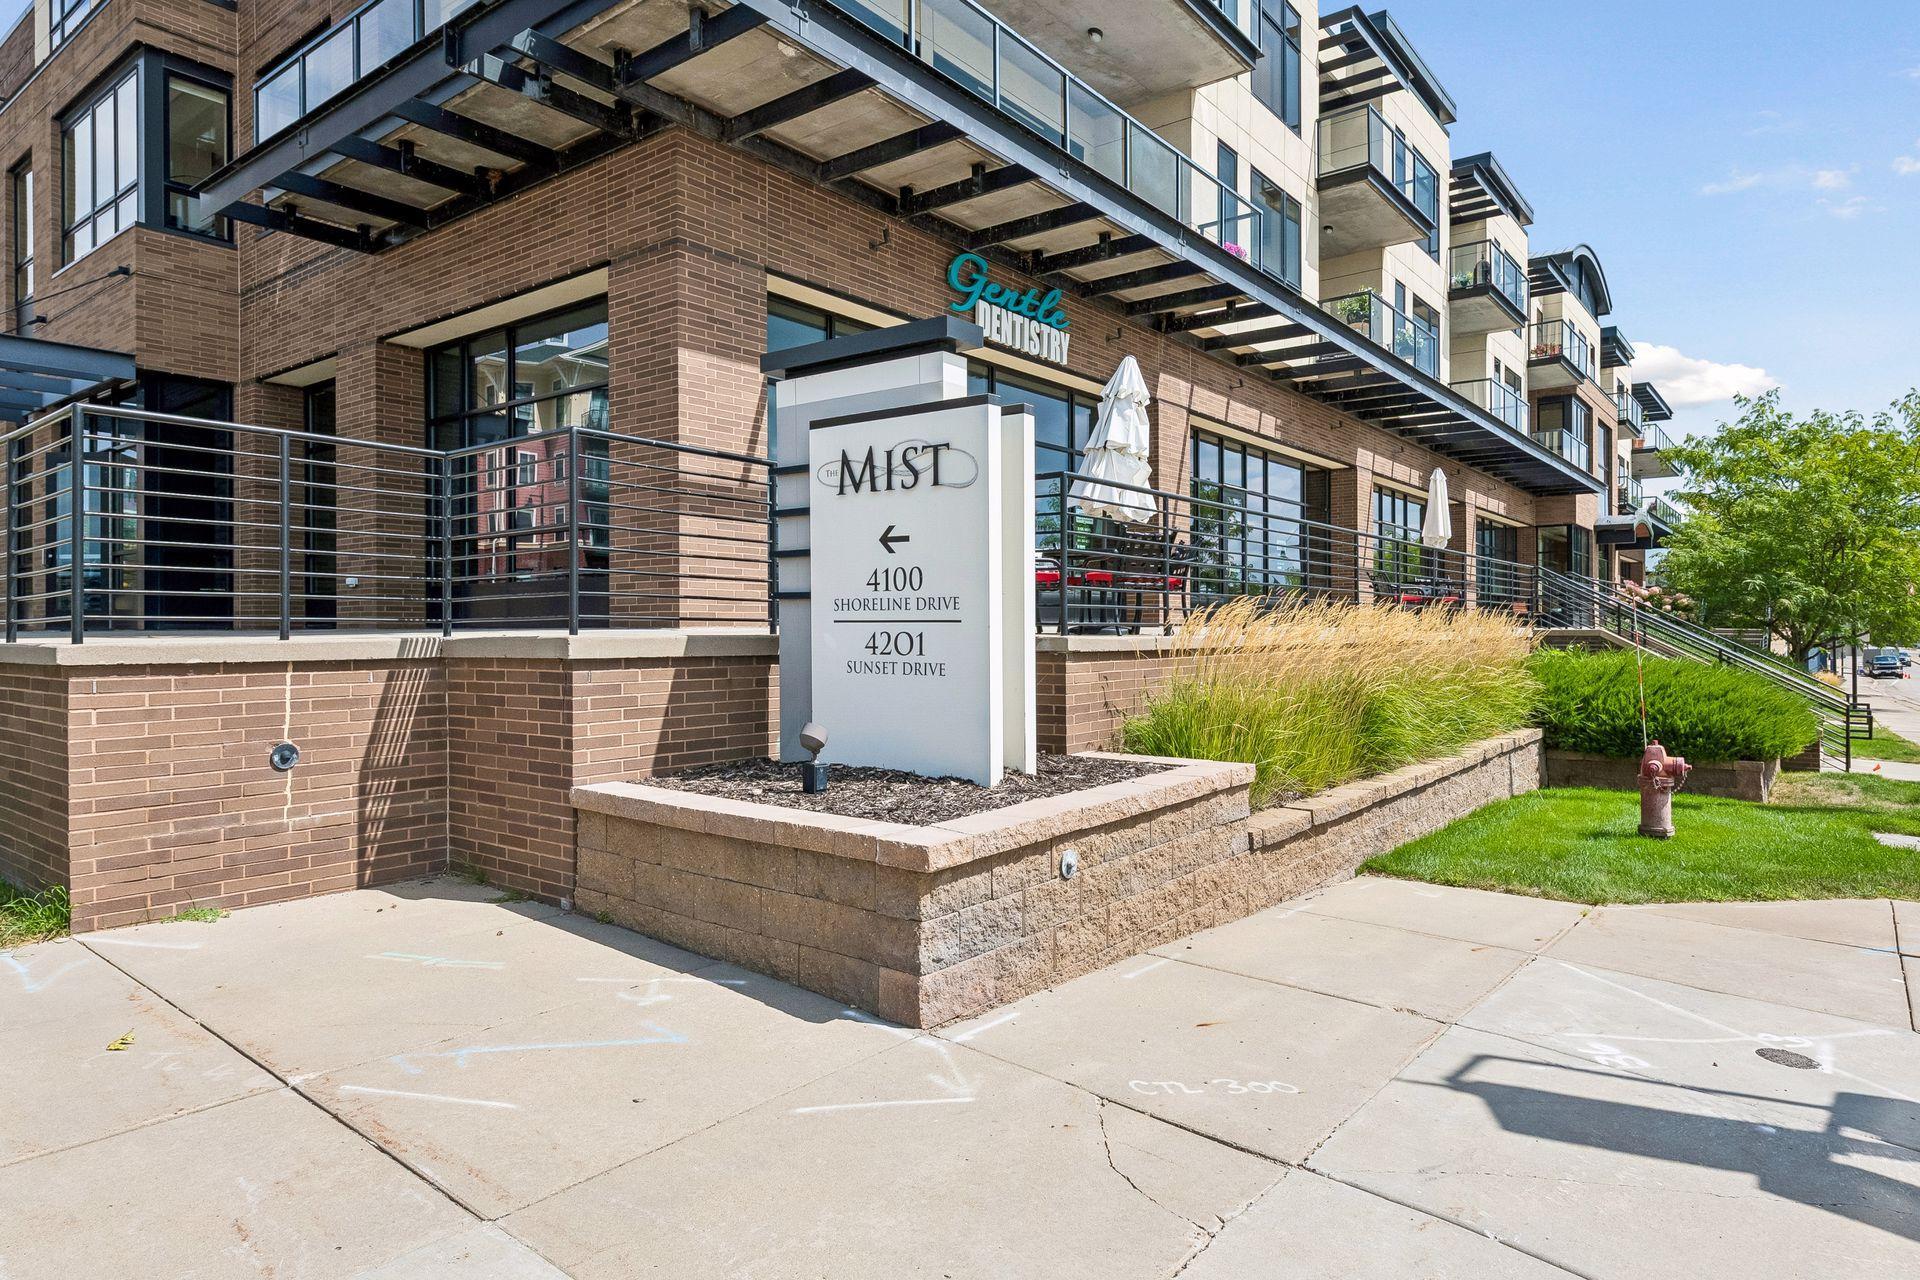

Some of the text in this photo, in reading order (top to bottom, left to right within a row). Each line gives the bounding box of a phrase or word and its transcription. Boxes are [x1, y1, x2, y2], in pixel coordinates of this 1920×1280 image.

[948, 253, 1071, 329] Gentle
[975, 299, 1070, 366] DENTISTRY
[826, 443, 950, 496] THE MIST
[866, 566, 923, 592] 4100
[833, 596, 960, 612] SHORELINE DRIVE
[865, 631, 925, 657] 4201
[846, 660, 946, 677] SUNSET DRIVE
[1210, 1079, 1301, 1094] 300
